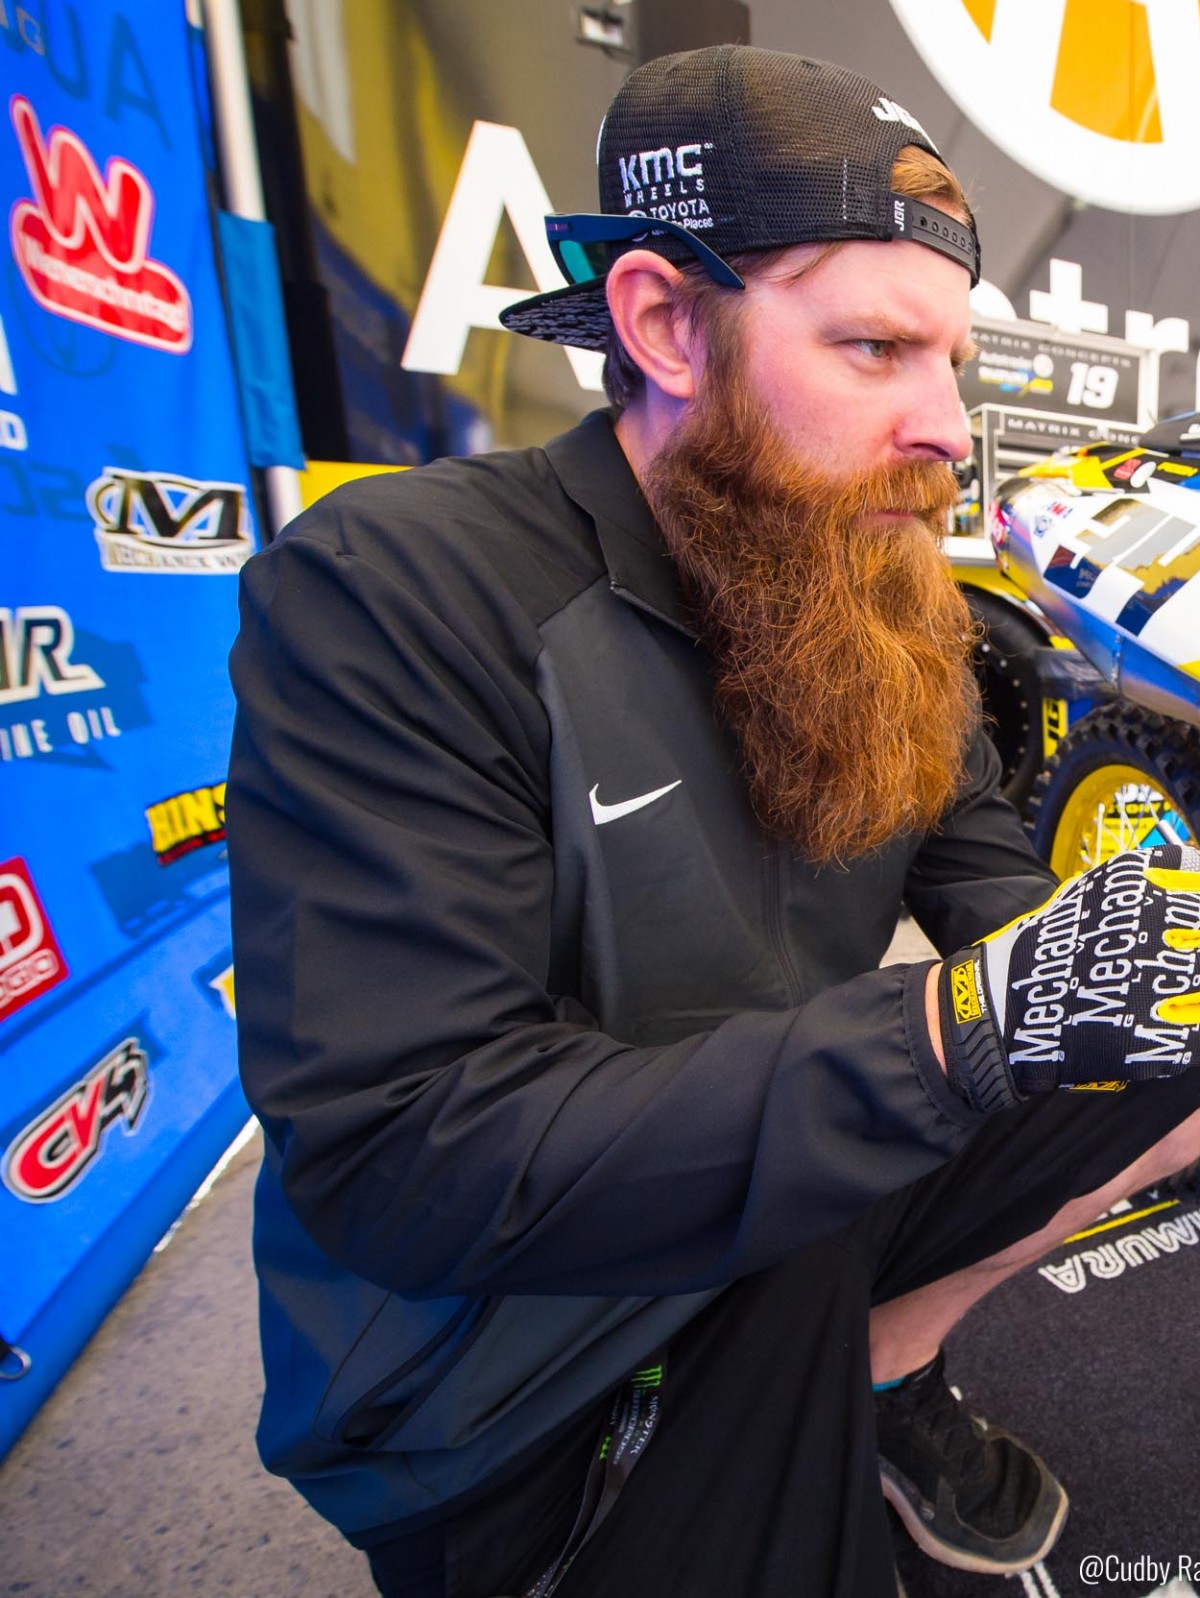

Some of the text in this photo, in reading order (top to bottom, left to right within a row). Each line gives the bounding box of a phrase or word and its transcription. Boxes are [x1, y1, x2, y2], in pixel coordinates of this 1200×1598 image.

[623, 178, 705, 208] WHEELS
[649, 198, 710, 220] TOYOTA
[894, 200, 905, 231] JGR
[1066, 362, 1119, 409] 19
[67, 706, 122, 744] OIL
